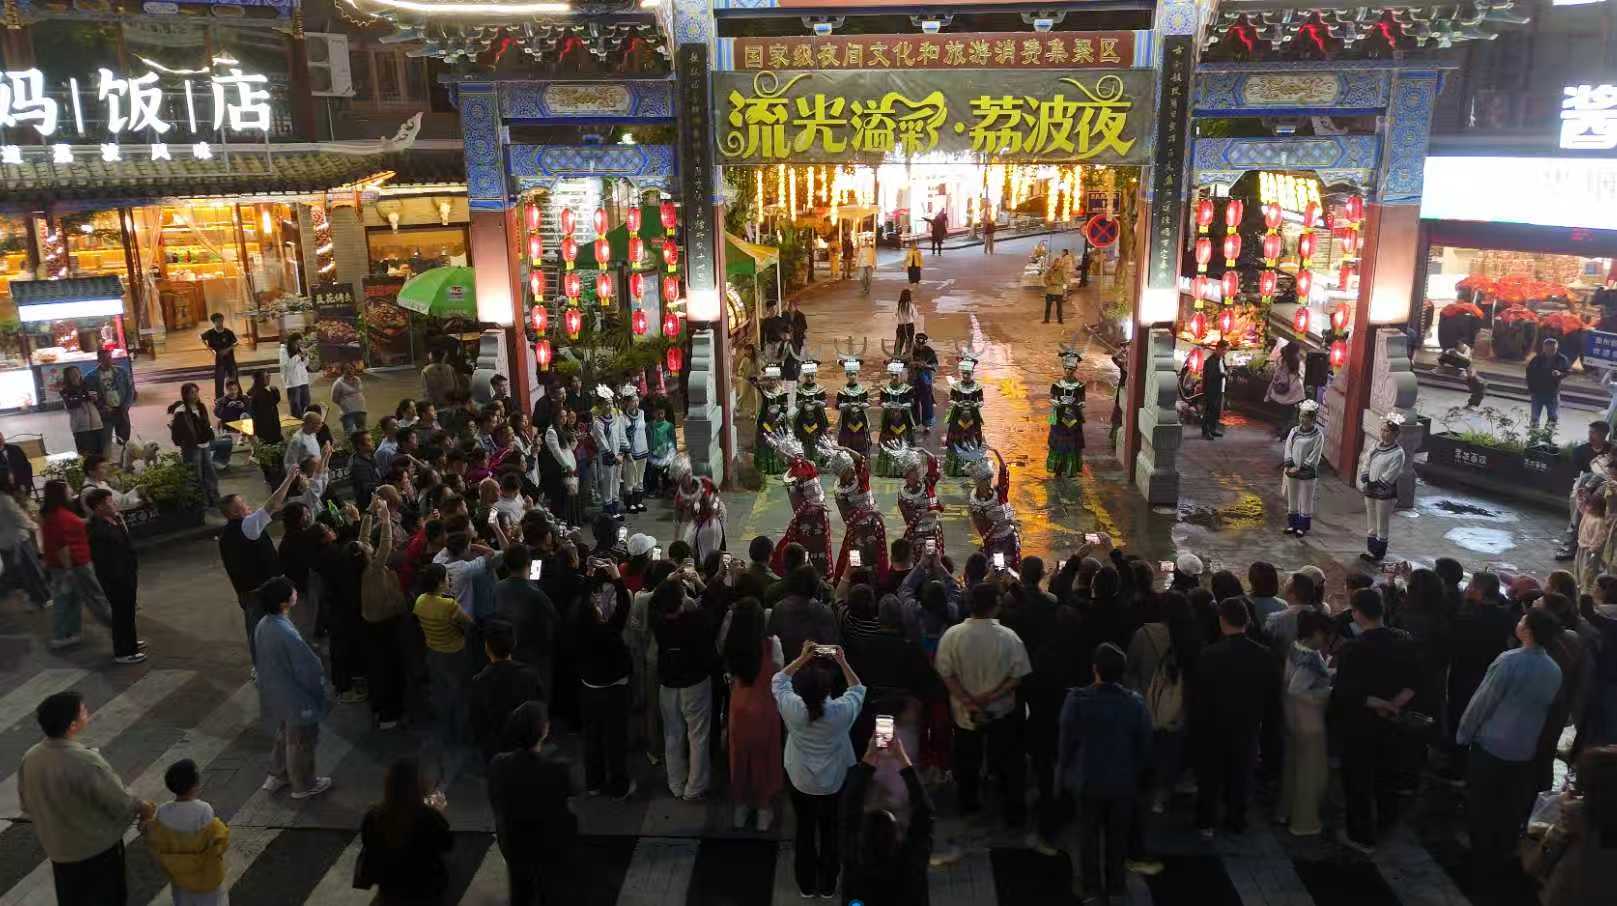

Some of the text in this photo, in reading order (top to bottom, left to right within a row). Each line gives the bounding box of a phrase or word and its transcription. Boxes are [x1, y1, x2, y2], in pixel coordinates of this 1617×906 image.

[744, 38, 1121, 69] 国家级夜间文化和旅游消费集聚区
